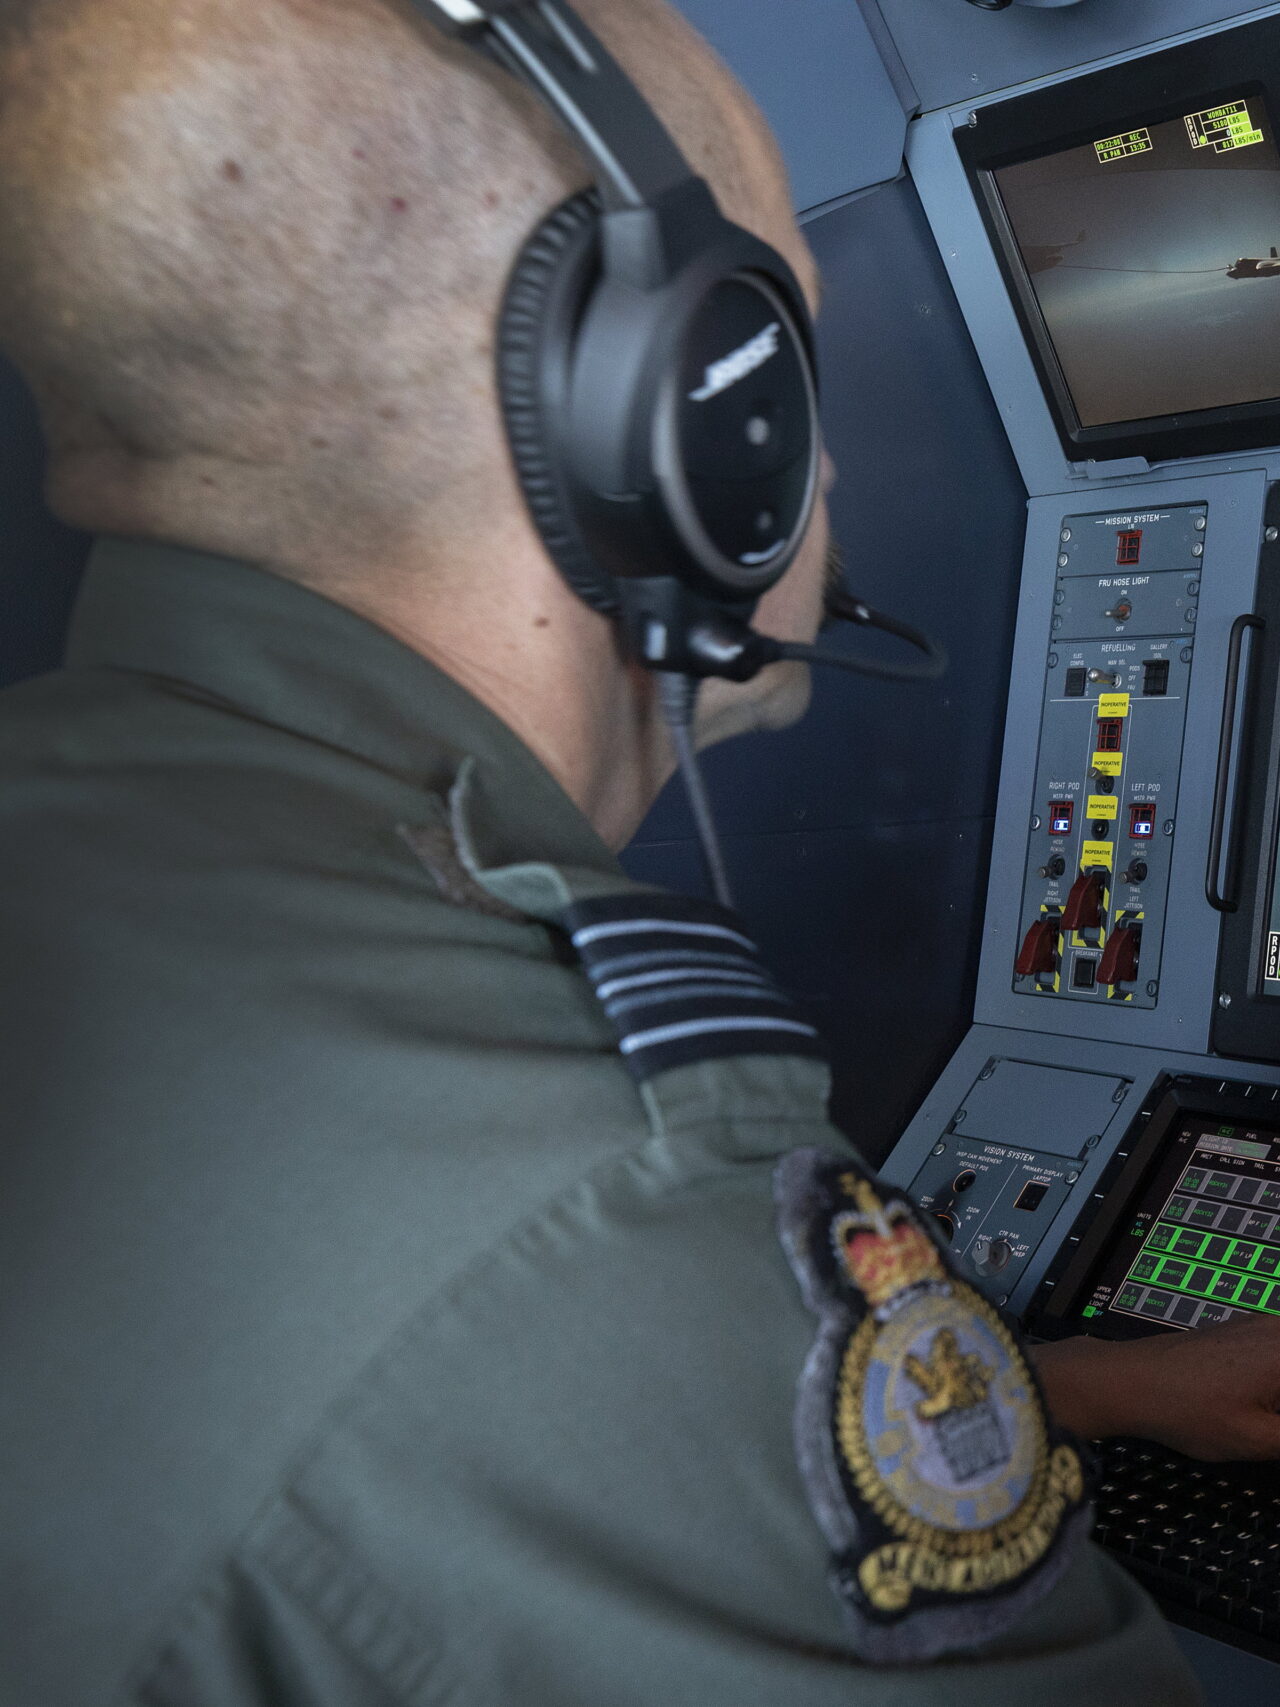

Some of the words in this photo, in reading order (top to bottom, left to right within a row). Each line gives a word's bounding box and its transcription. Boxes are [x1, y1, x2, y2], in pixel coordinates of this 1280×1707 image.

[1129, 133, 1141, 142] REC
[1103, 152, 1109, 160] R
[1110, 149, 1121, 158] PAN
[1130, 142, 1146, 152] 13:35
[1105, 516, 1131, 525] MISSION
[1134, 514, 1160, 522] SYSTEM
[1098, 579, 1112, 587] FRU
[1113, 578, 1130, 586] HOSE
[1132, 576, 1150, 585] LIGHT
[1101, 643, 1136, 652] REFUELLING
[1049, 782, 1066, 790] RIGHT
[1068, 782, 1080, 790] POD
[1131, 783, 1145, 791] LEFT
[1147, 784, 1161, 792] POD
[984, 1145, 1006, 1157] VISION
[1007, 1150, 1035, 1162] SYSTEM
[1022, 1165, 1043, 1174] PRIMARY
[1043, 1169, 1063, 1178] DISPLAY
